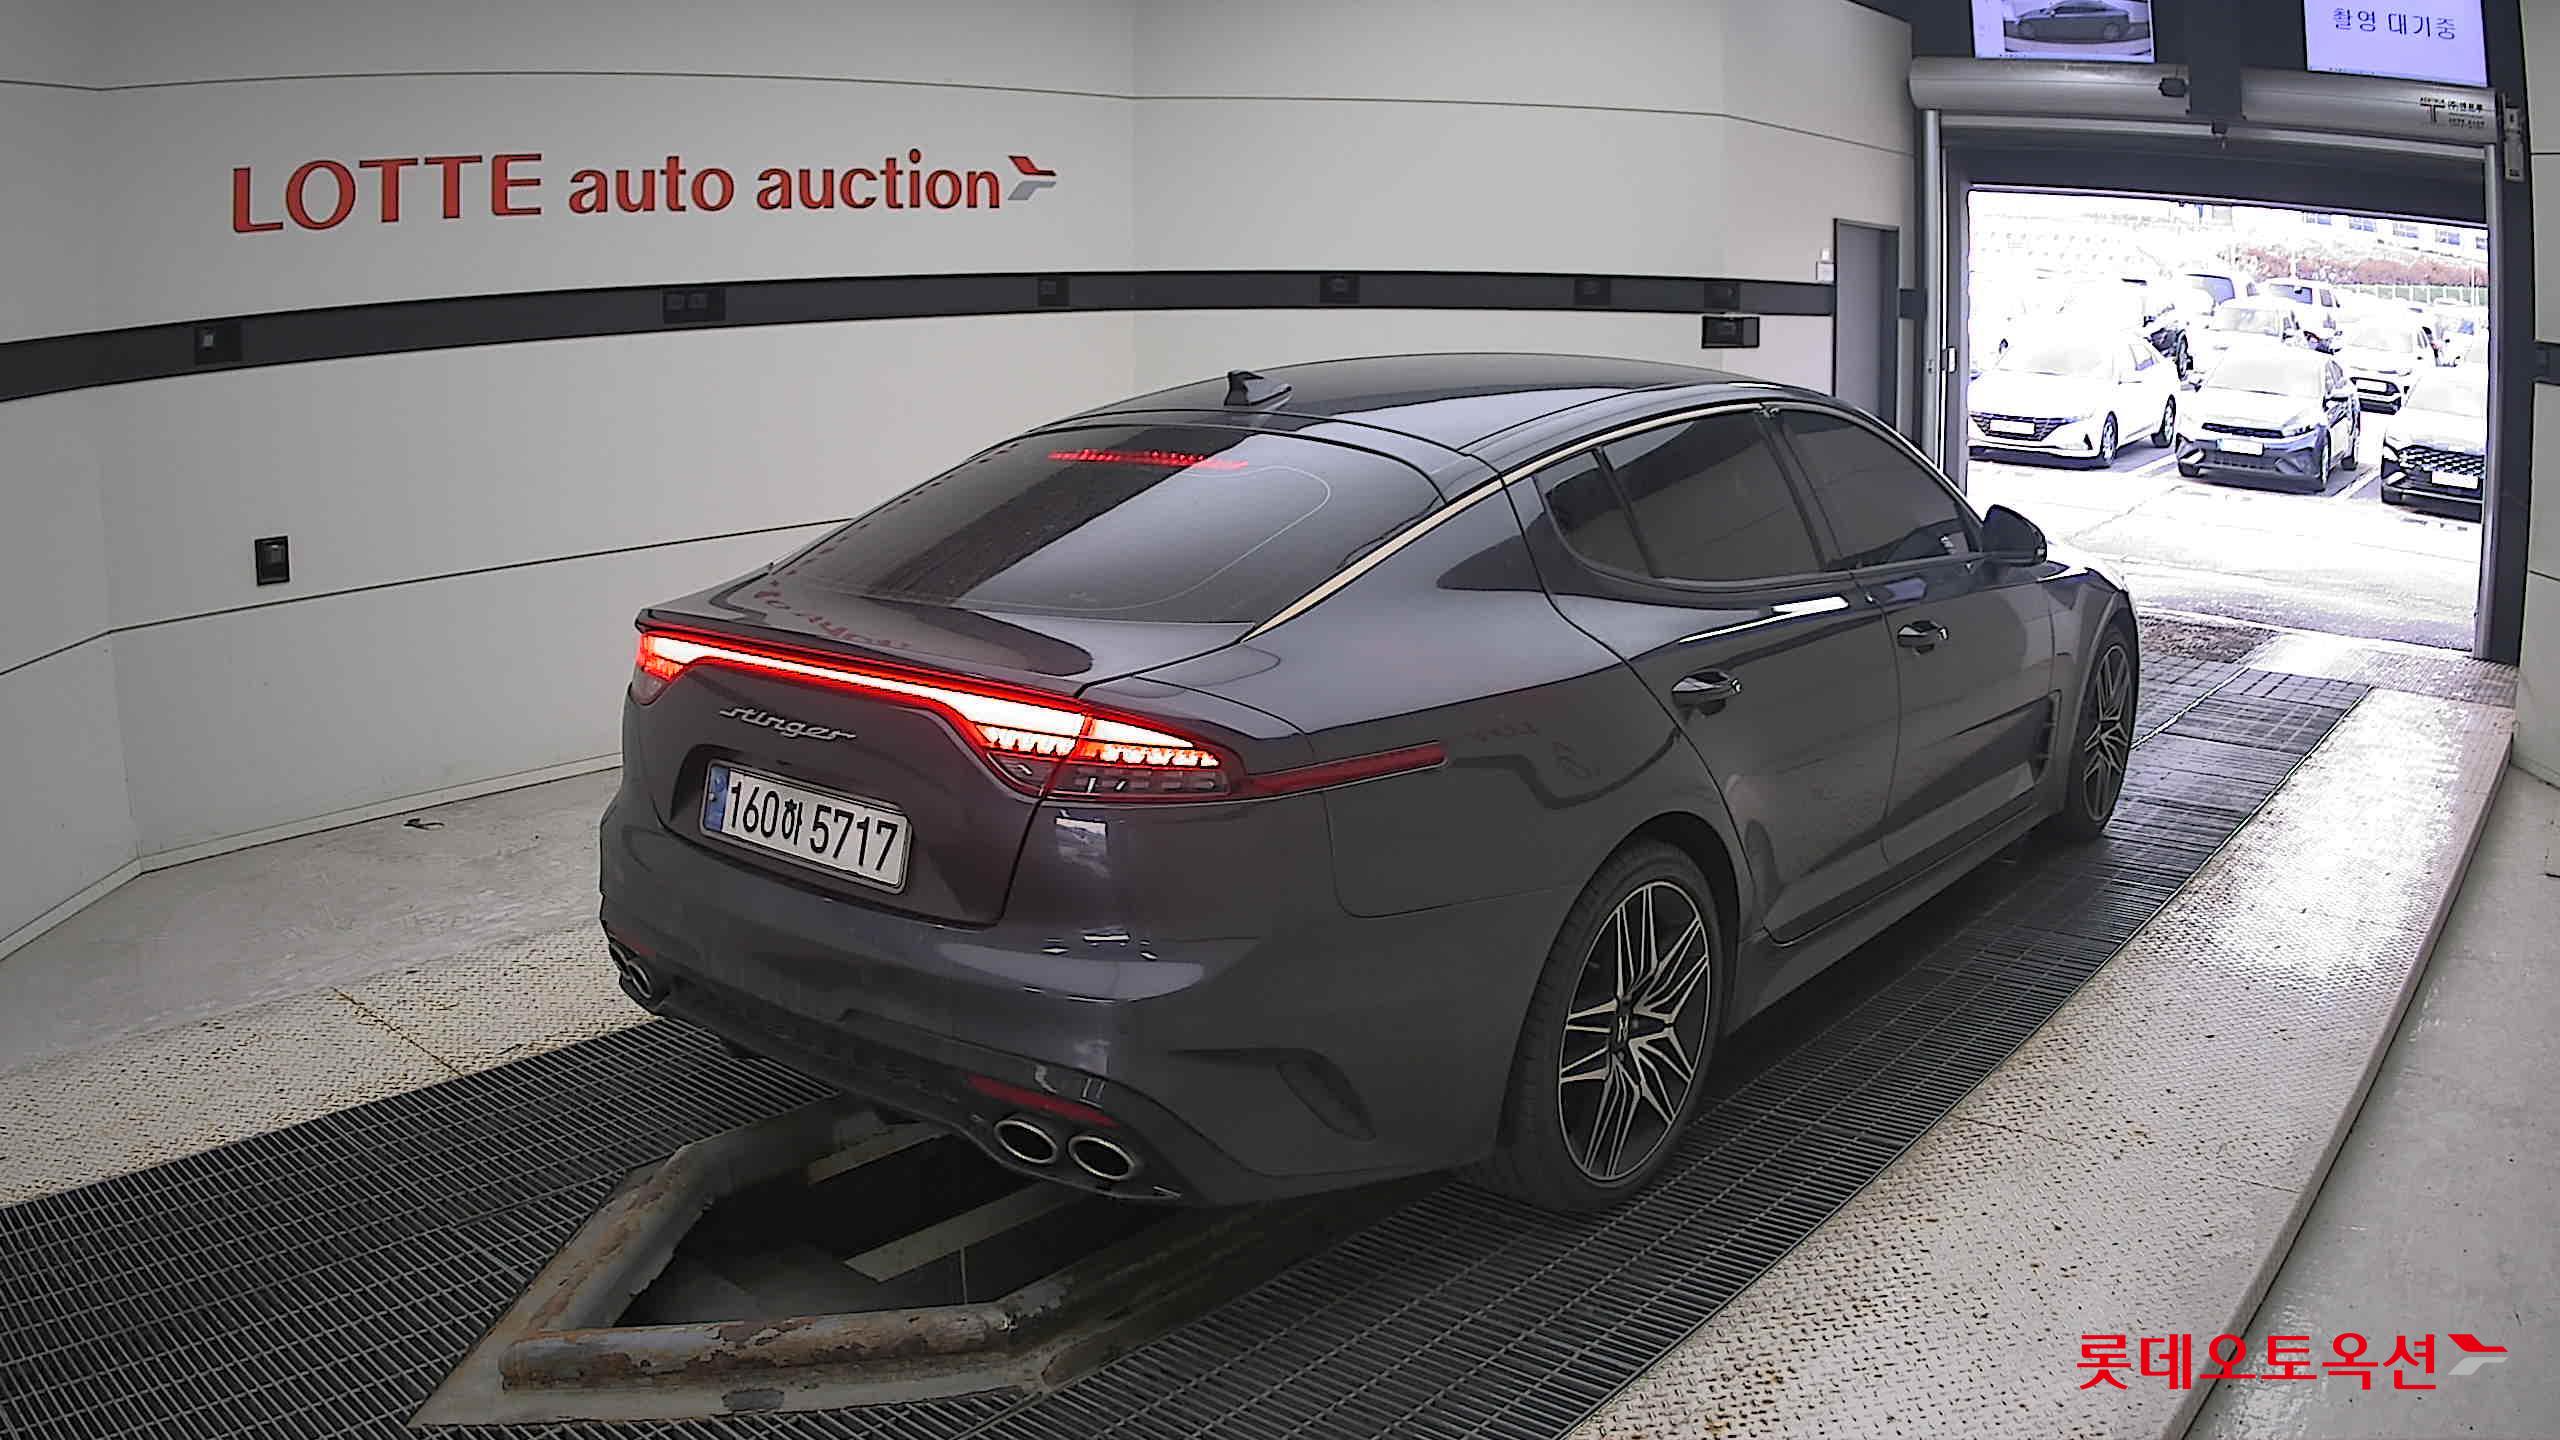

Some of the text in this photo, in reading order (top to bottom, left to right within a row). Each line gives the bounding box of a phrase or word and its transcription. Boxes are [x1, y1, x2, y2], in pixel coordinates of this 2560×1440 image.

[2333, 8, 2456, 41] 촬영 대기중
[232, 149, 1002, 234] LOTTE auto auction
[809, 803, 899, 872] 5717
